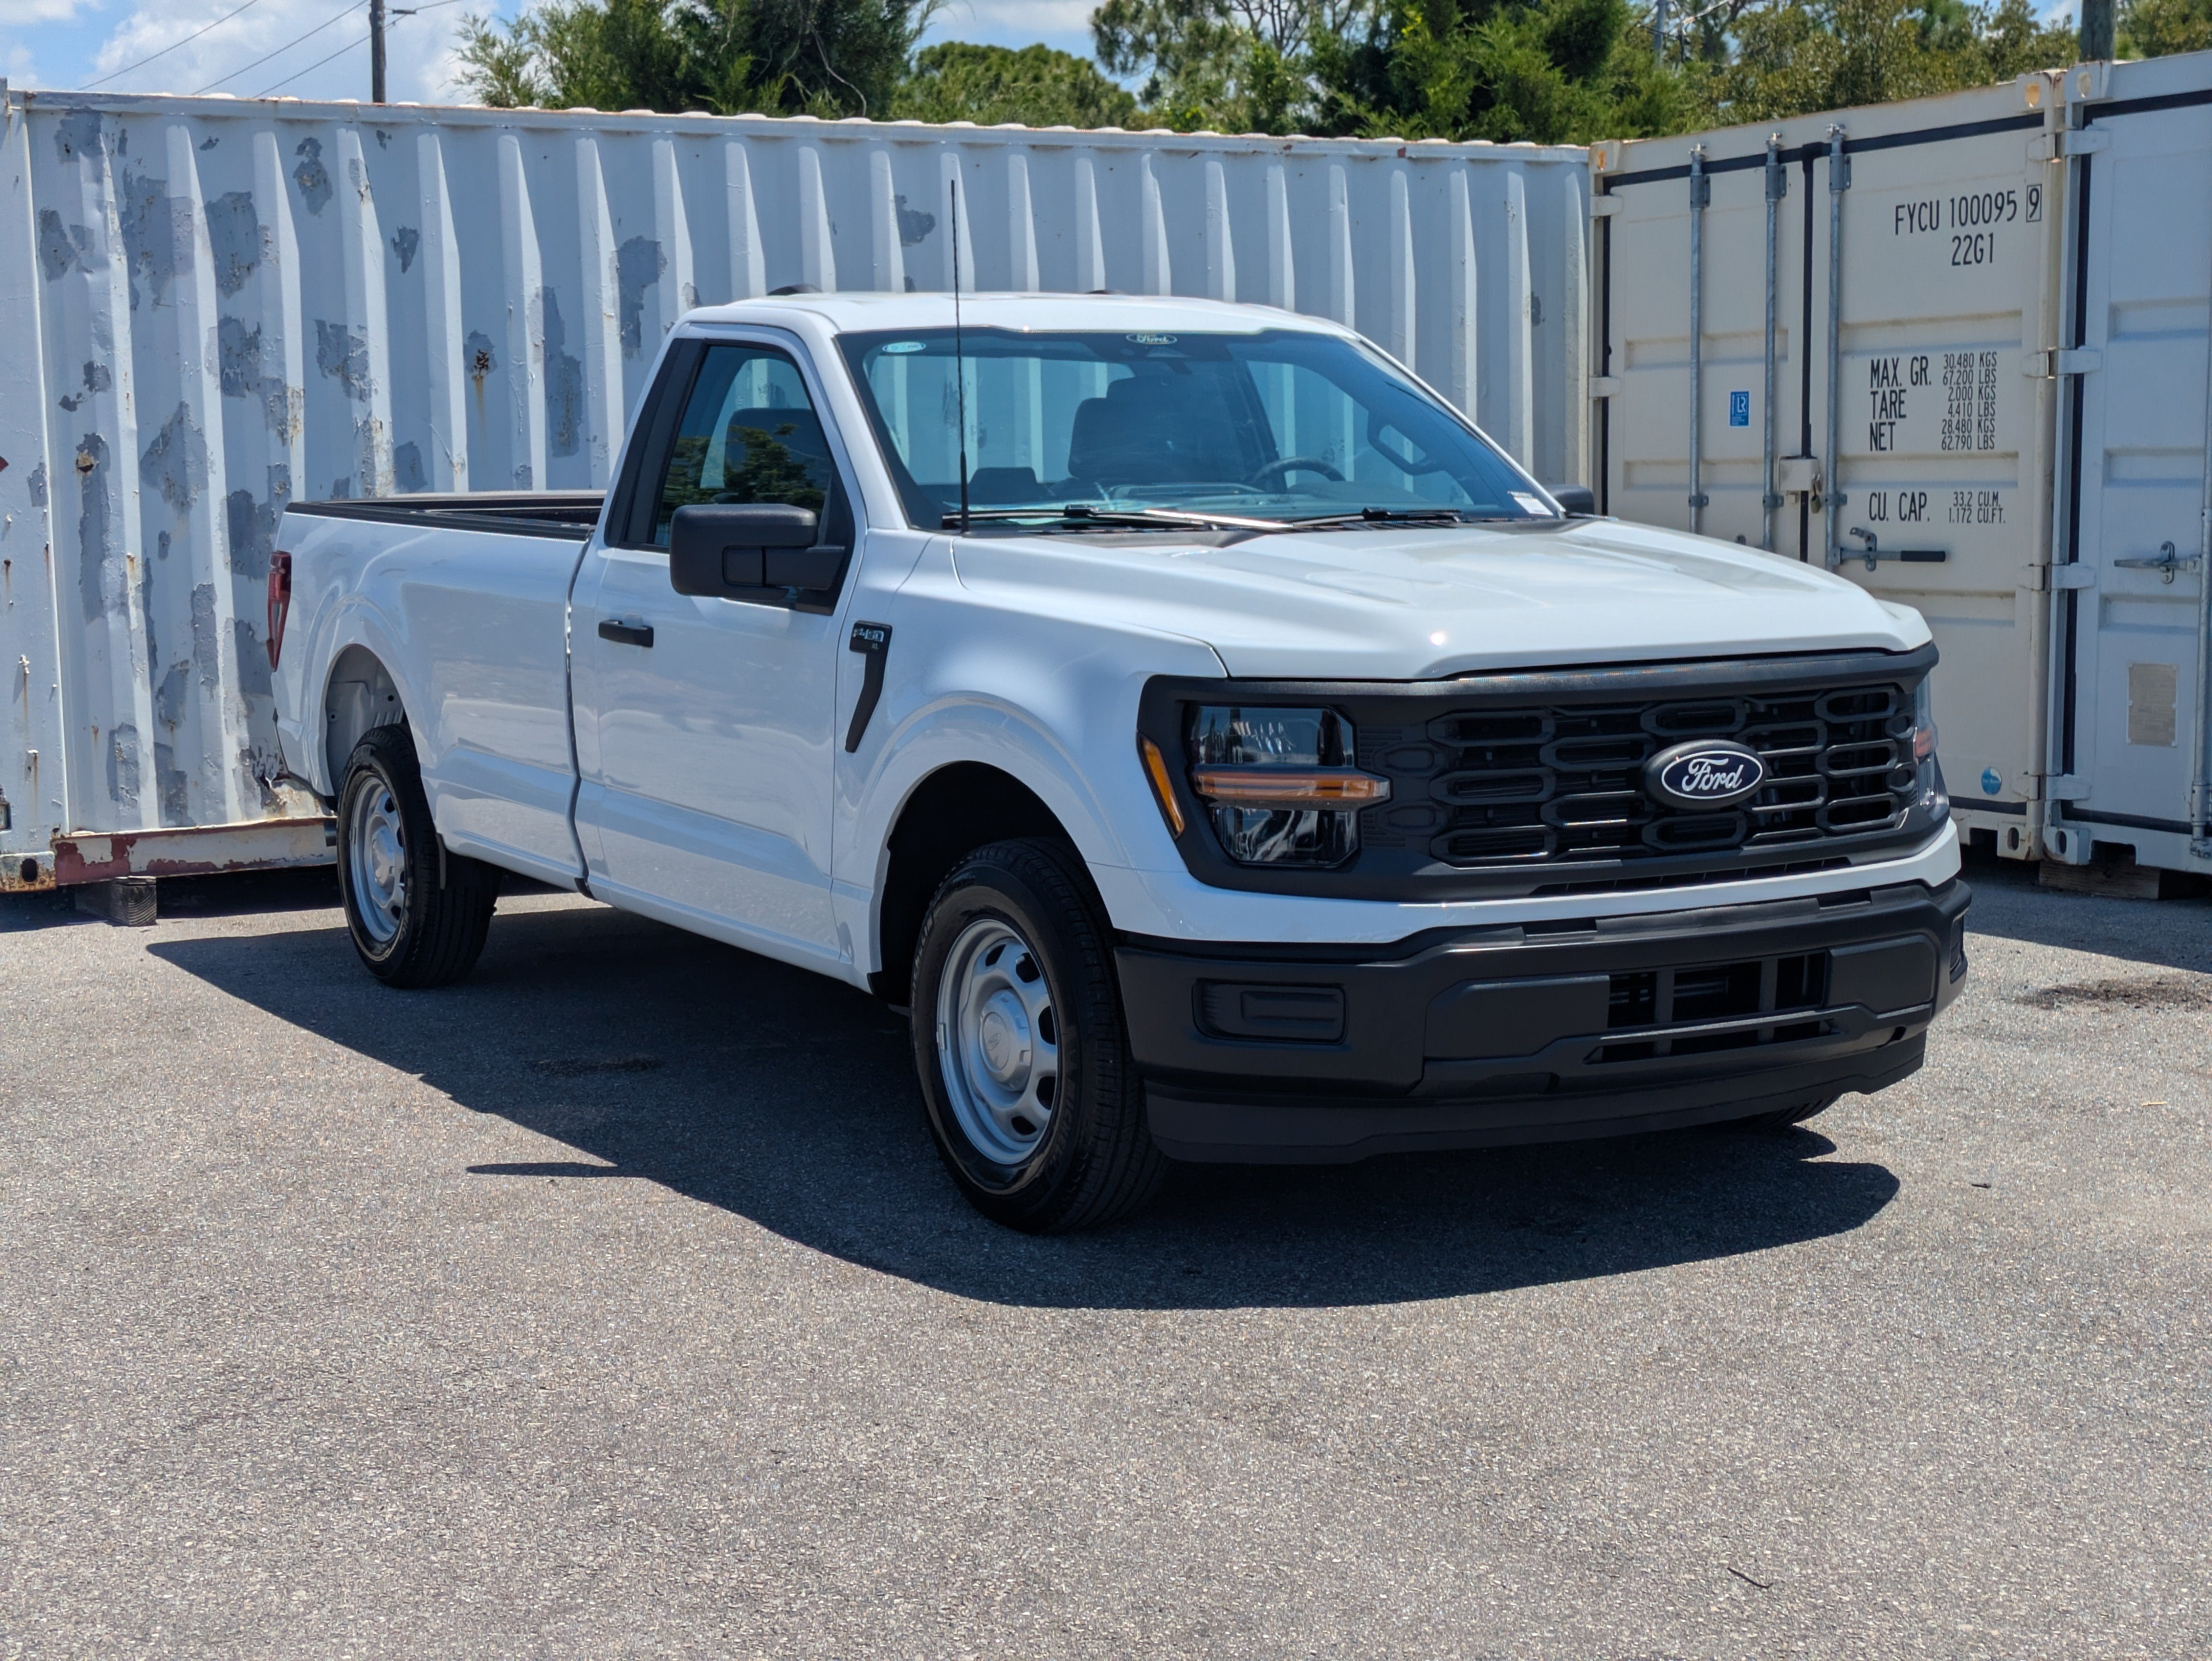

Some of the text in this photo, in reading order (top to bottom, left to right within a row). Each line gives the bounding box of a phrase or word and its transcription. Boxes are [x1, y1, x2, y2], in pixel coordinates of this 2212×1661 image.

[1895, 187, 2040, 235] FYCU 100095 9
[1951, 232, 1994, 266] 22G1
[1943, 352, 1997, 369] 30.480 KGS
[1870, 355, 1932, 388] MAX. GR.
[1942, 368, 1997, 386] 67.200 LBS
[1948, 385, 1996, 402] 2.000 KGS
[1870, 388, 1907, 420] TARE
[1947, 401, 1996, 418] 4.410 LBS
[1941, 418, 1995, 435] 28.480 KGS
[1869, 421, 1896, 452] NET
[1941, 434, 1995, 451] 62.790 LBS
[1869, 492, 1930, 522] CU. CAP.
[1953, 491, 2001, 507] 33.2 CU.M.
[1949, 507, 2006, 523] 1.172 CU.FT.
[1681, 758, 1744, 792] Ford
